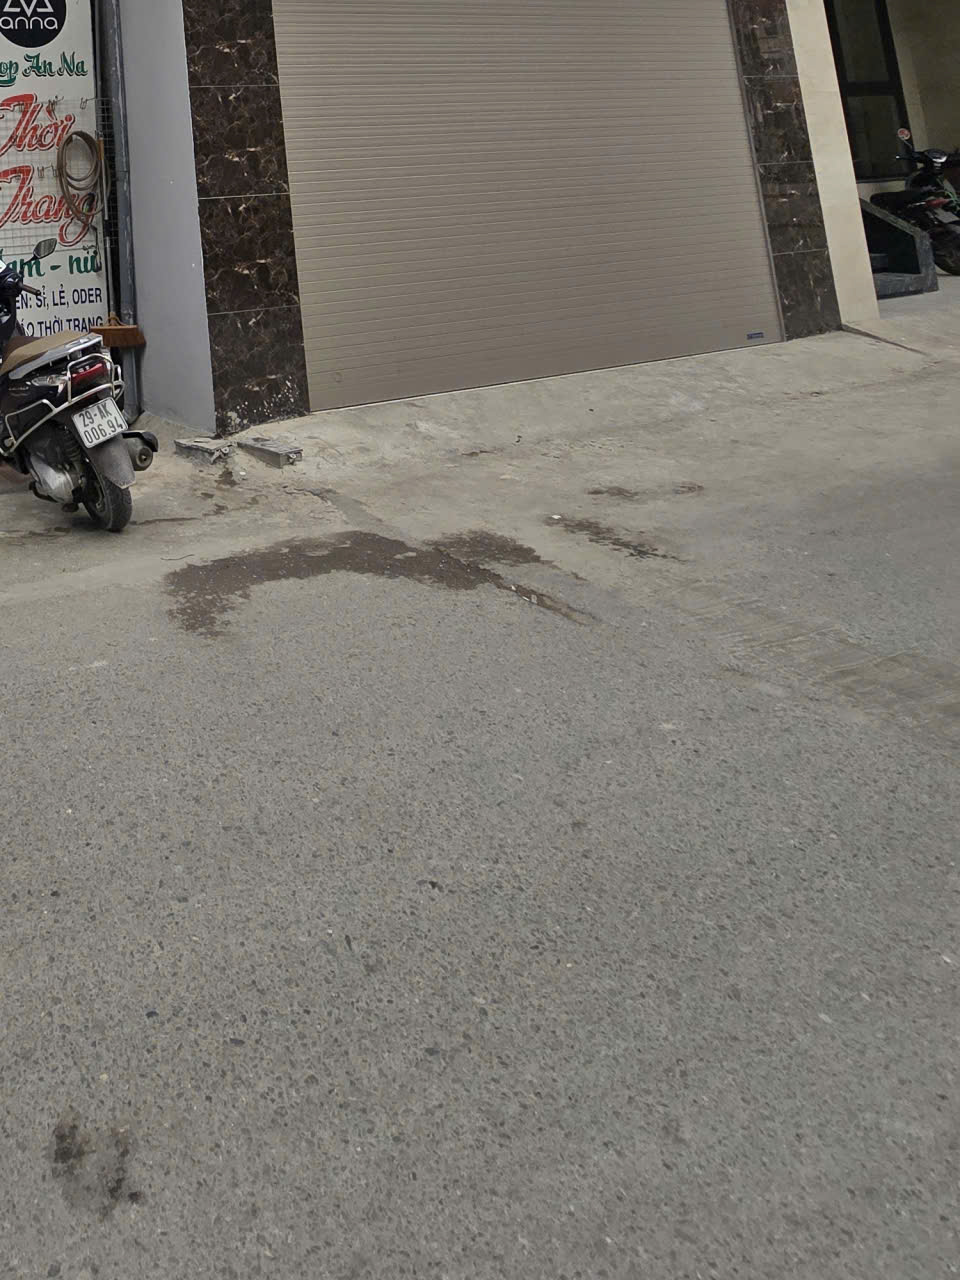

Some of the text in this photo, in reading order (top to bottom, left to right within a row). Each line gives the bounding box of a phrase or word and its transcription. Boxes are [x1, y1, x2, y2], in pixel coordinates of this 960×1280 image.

[0, 16, 58, 30] anna
[22, 53, 55, 77] An
[56, 51, 89, 77] Na
[72, 287, 103, 305] ODER
[66, 316, 104, 333] TRANG
[79, 402, 113, 428] 29-AK
[84, 417, 124, 444] 006.94
